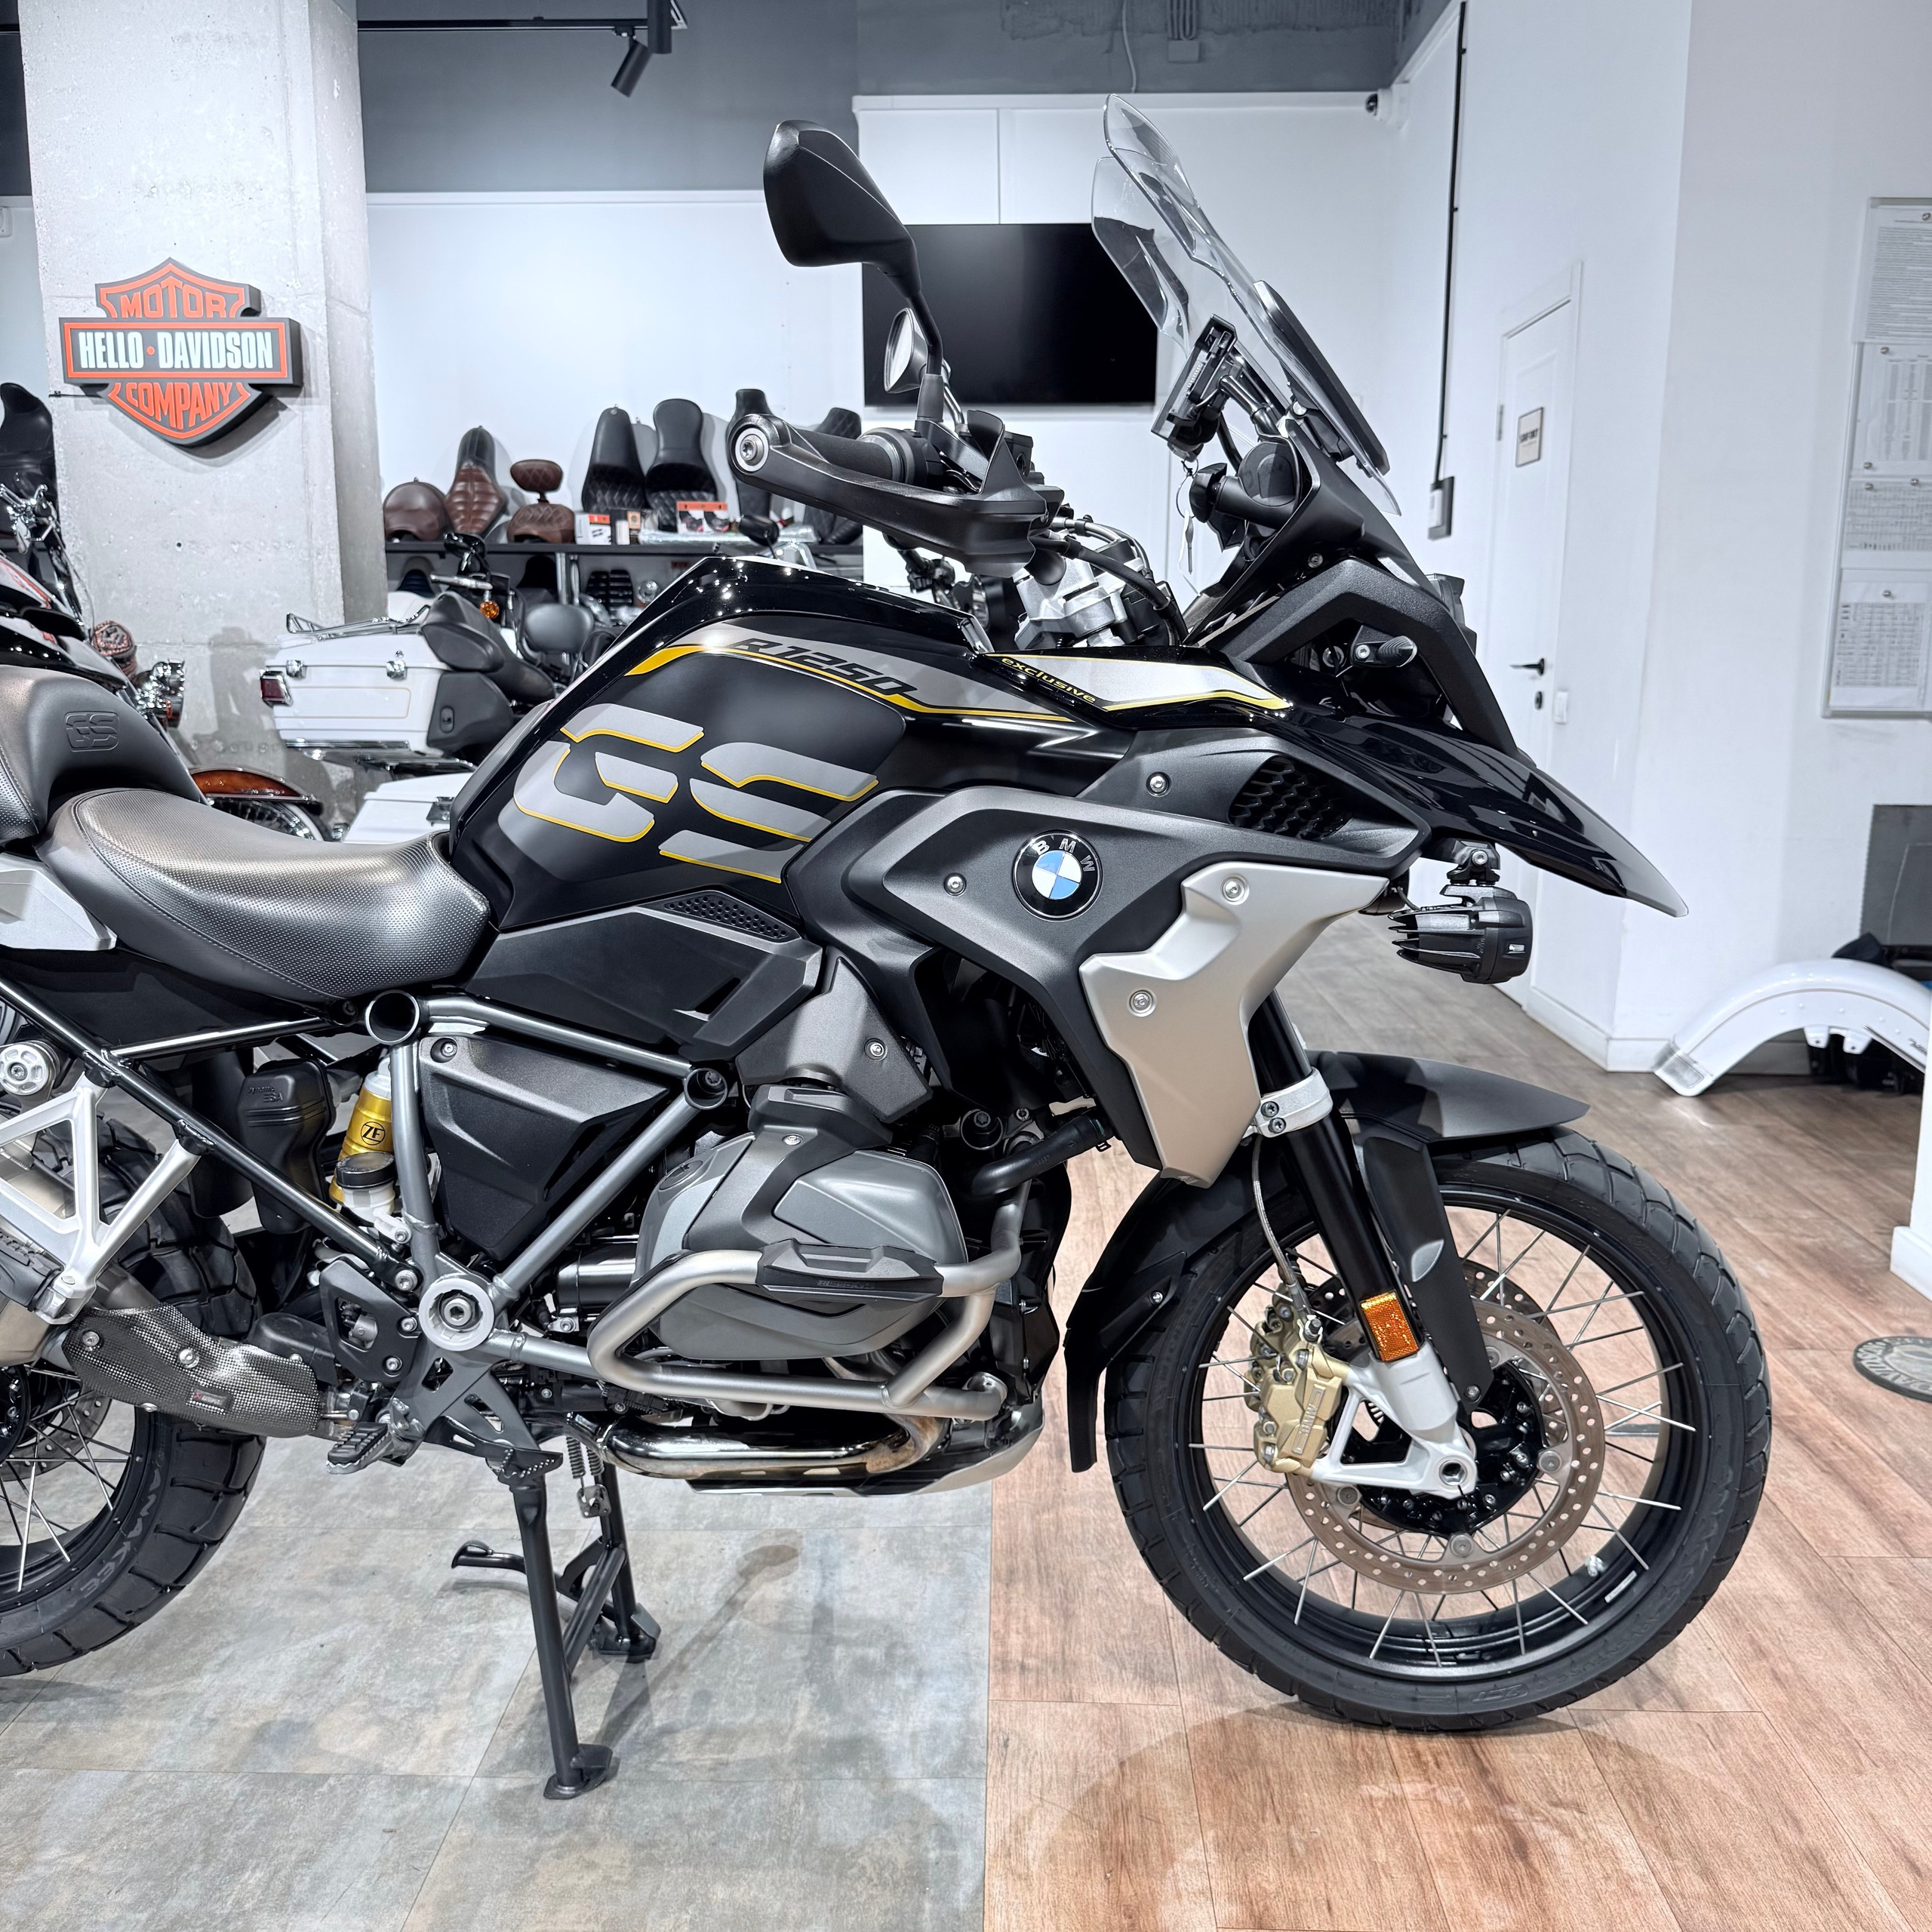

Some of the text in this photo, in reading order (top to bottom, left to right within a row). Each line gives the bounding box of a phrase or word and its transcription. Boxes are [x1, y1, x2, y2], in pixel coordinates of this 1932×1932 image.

[120, 275, 226, 318] MOTOR
[78, 331, 273, 369] HELLO DAVIDSON
[126, 382, 233, 430] COMPANY
[1001, 657, 1096, 703] exclusive
[65, 712, 119, 750] GS
[513, 703, 878, 884] GS
[1031, 838, 1096, 872] BMW
[361, 1123, 386, 1142] ZF
[1300, 1402, 1319, 1435] BMW
